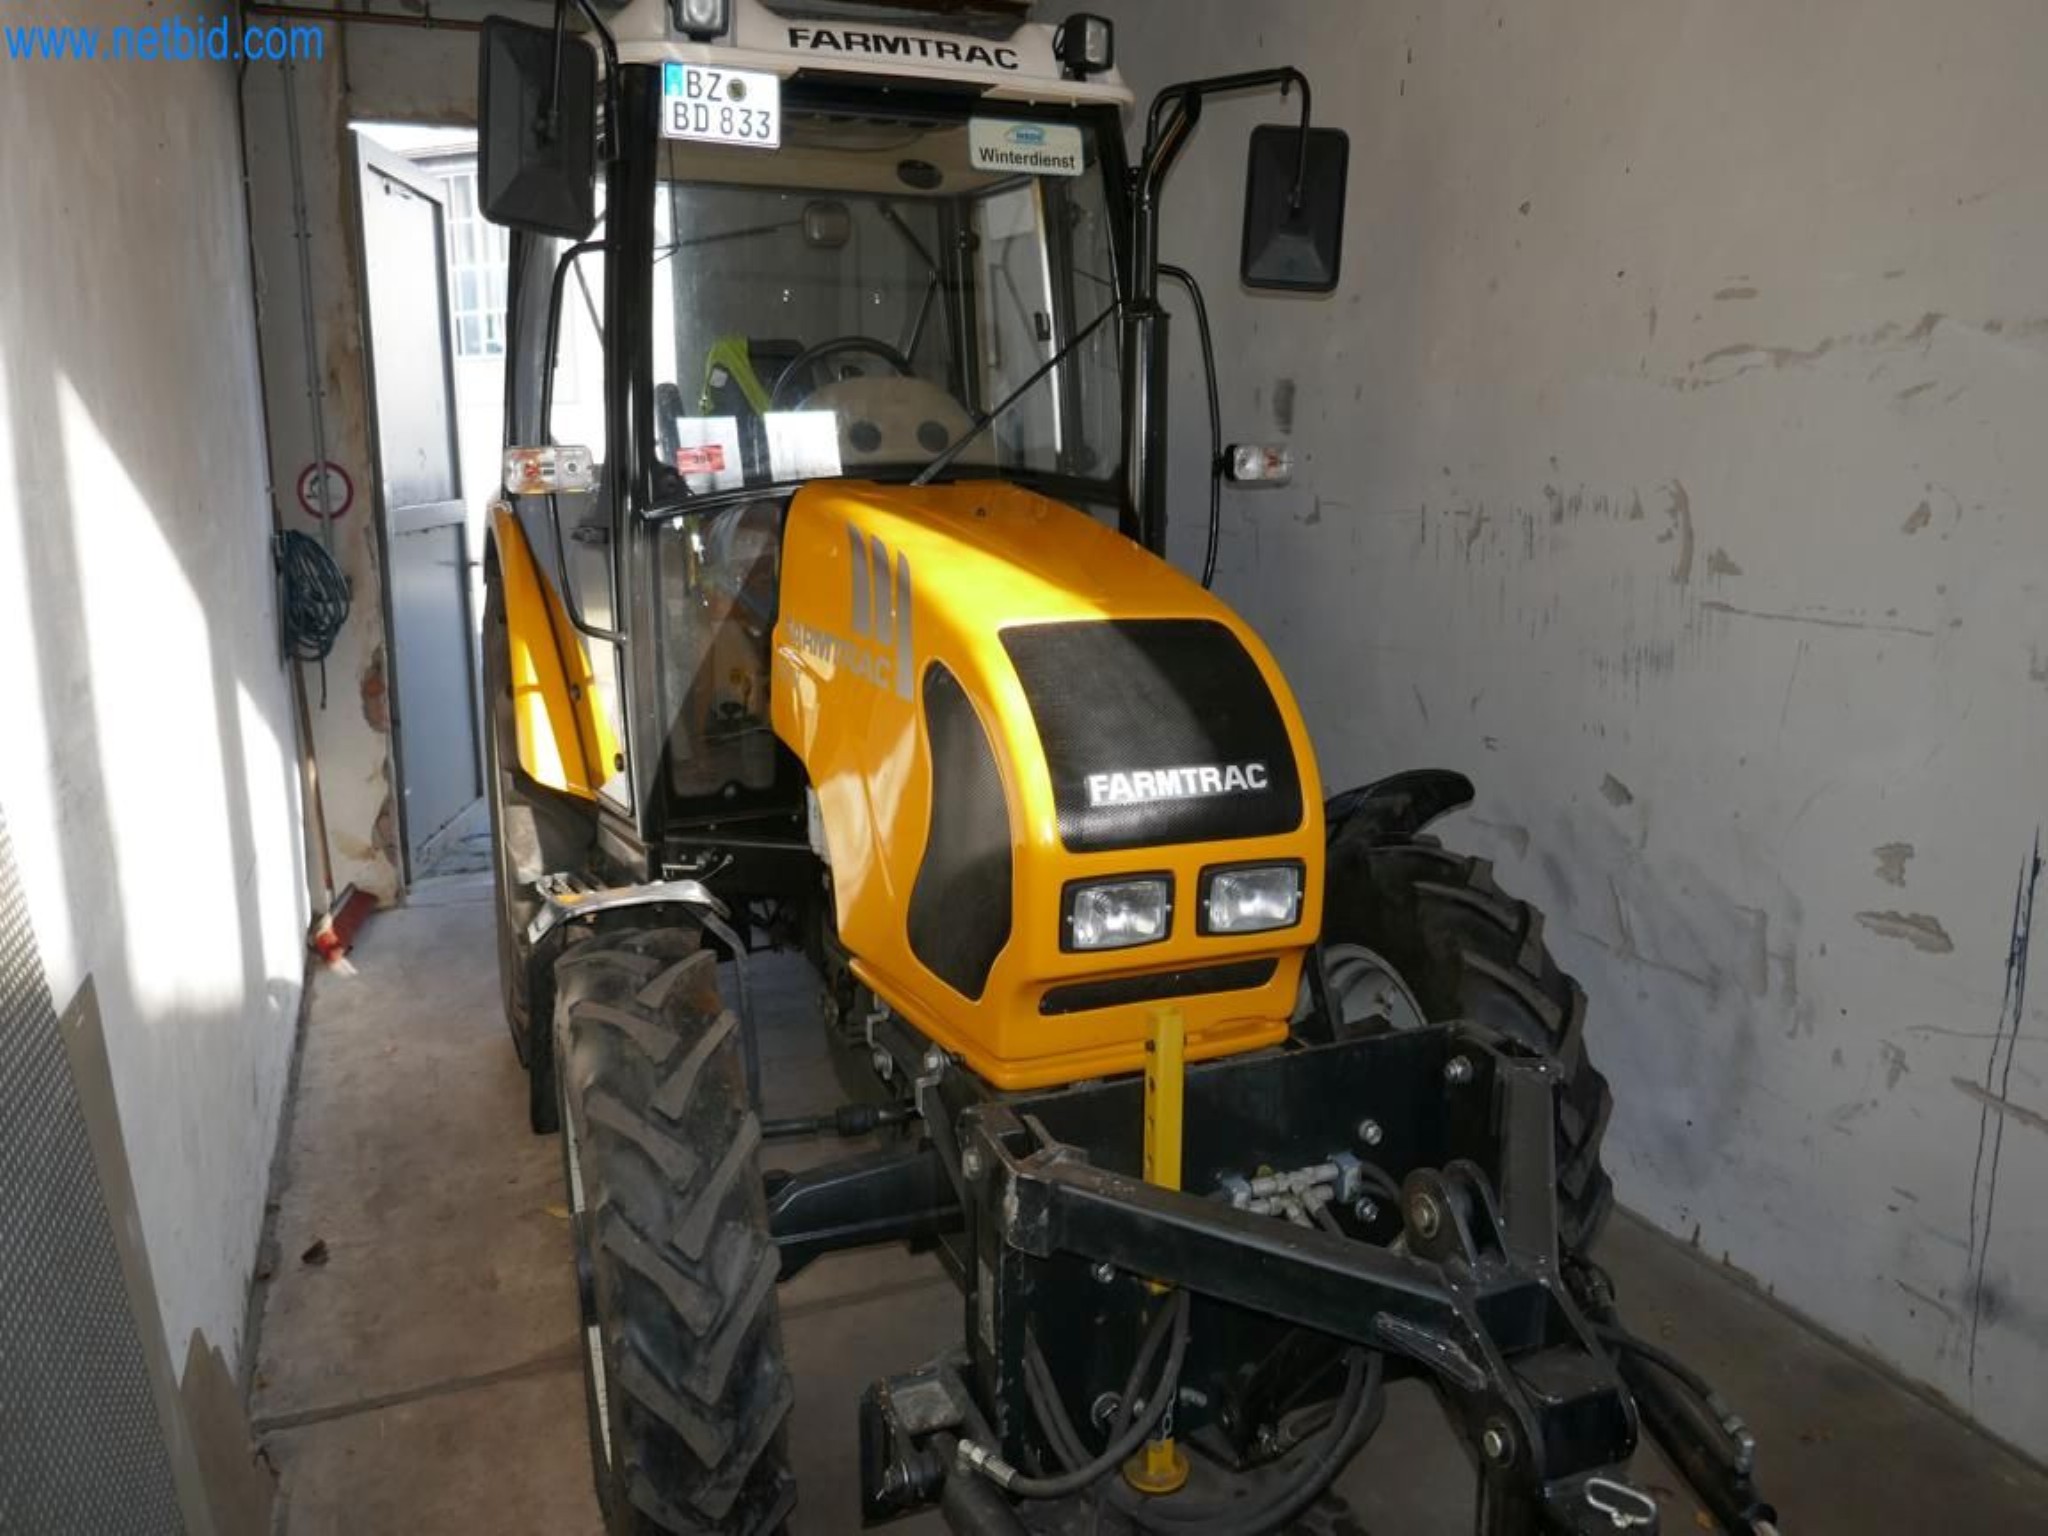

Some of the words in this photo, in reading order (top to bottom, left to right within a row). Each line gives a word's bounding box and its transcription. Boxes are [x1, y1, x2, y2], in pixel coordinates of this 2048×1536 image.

[788, 27, 1018, 70] FARMTRAC
[686, 69, 723, 102] BZ
[674, 101, 709, 132] BD
[720, 106, 770, 139] 833
[978, 146, 1075, 170] Winterdienst
[1086, 763, 1268, 807] FARMTRAC
